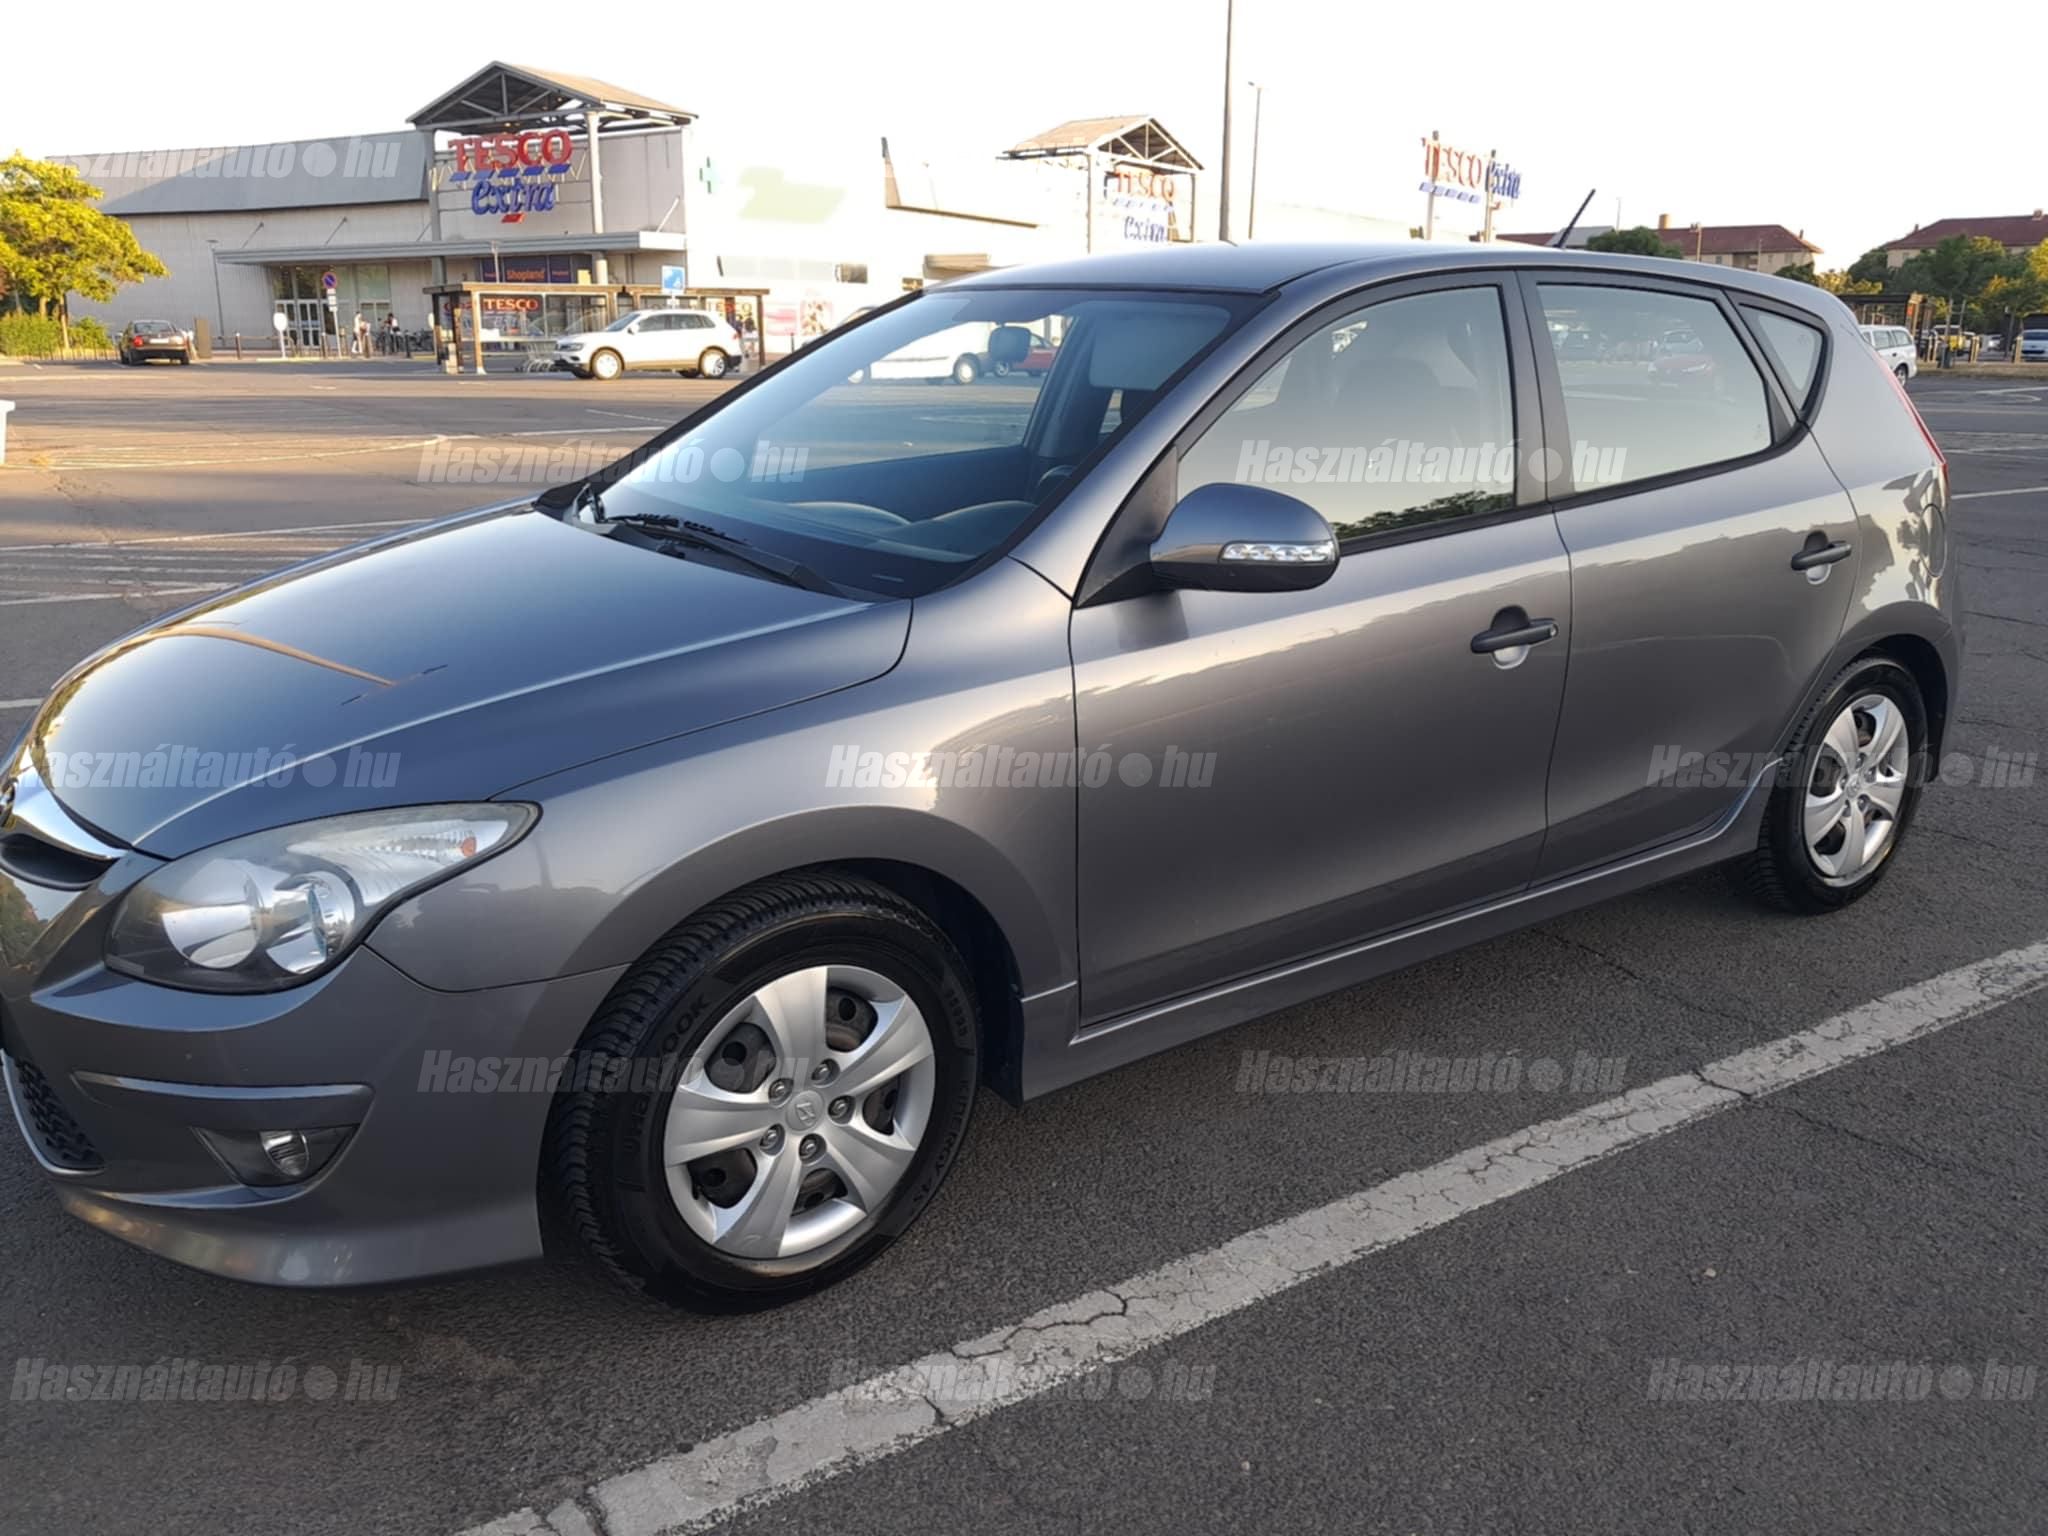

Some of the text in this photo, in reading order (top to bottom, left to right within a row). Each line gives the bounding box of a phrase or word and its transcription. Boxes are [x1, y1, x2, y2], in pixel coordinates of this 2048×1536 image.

[448, 129, 573, 173] TESCO
[472, 177, 555, 216] extra
[483, 298, 539, 311] TESCO
